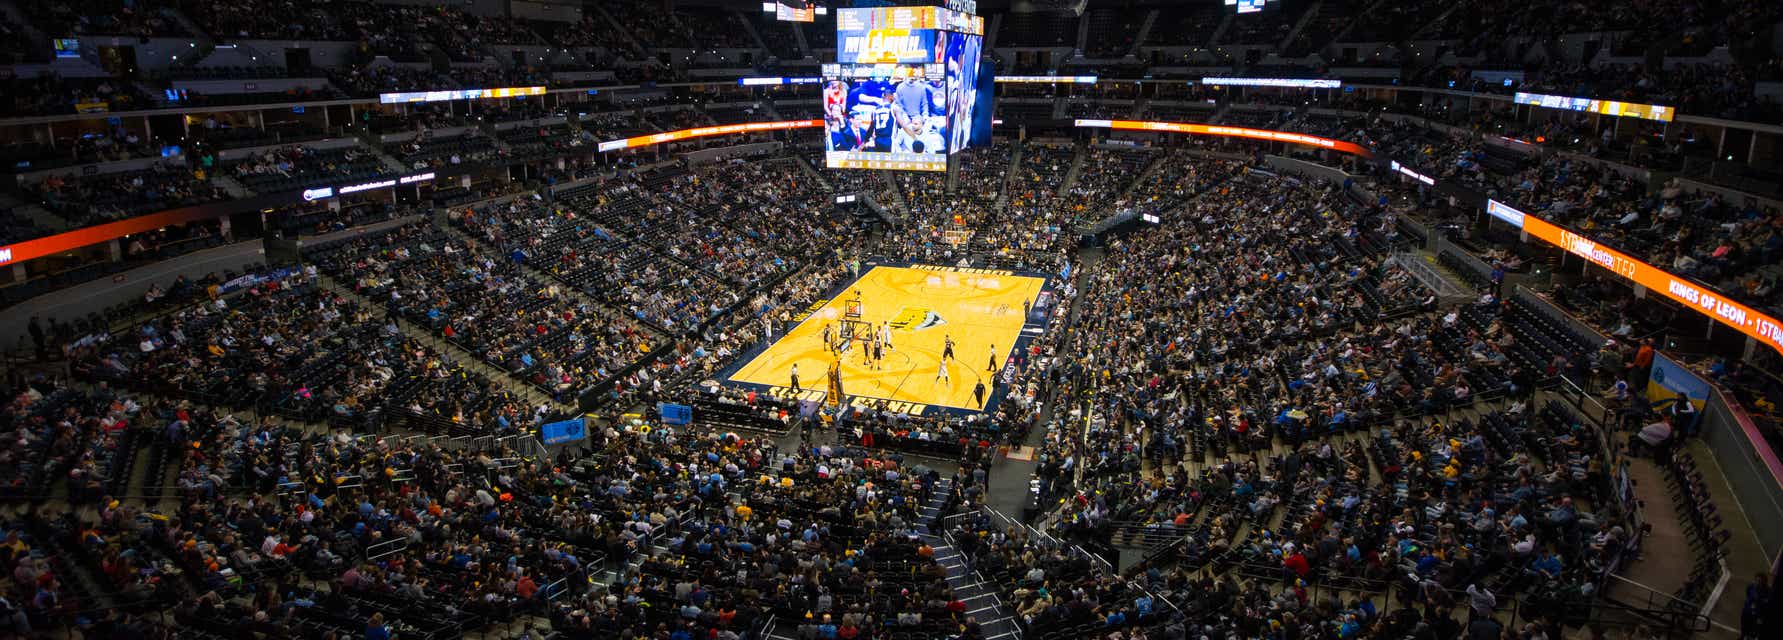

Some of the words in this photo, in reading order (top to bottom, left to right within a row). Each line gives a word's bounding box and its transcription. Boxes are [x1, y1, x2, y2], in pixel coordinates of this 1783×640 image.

[1668, 279, 1699, 304] KINGS
[1700, 294, 1716, 310] OF
[1715, 300, 1747, 326] LEON
